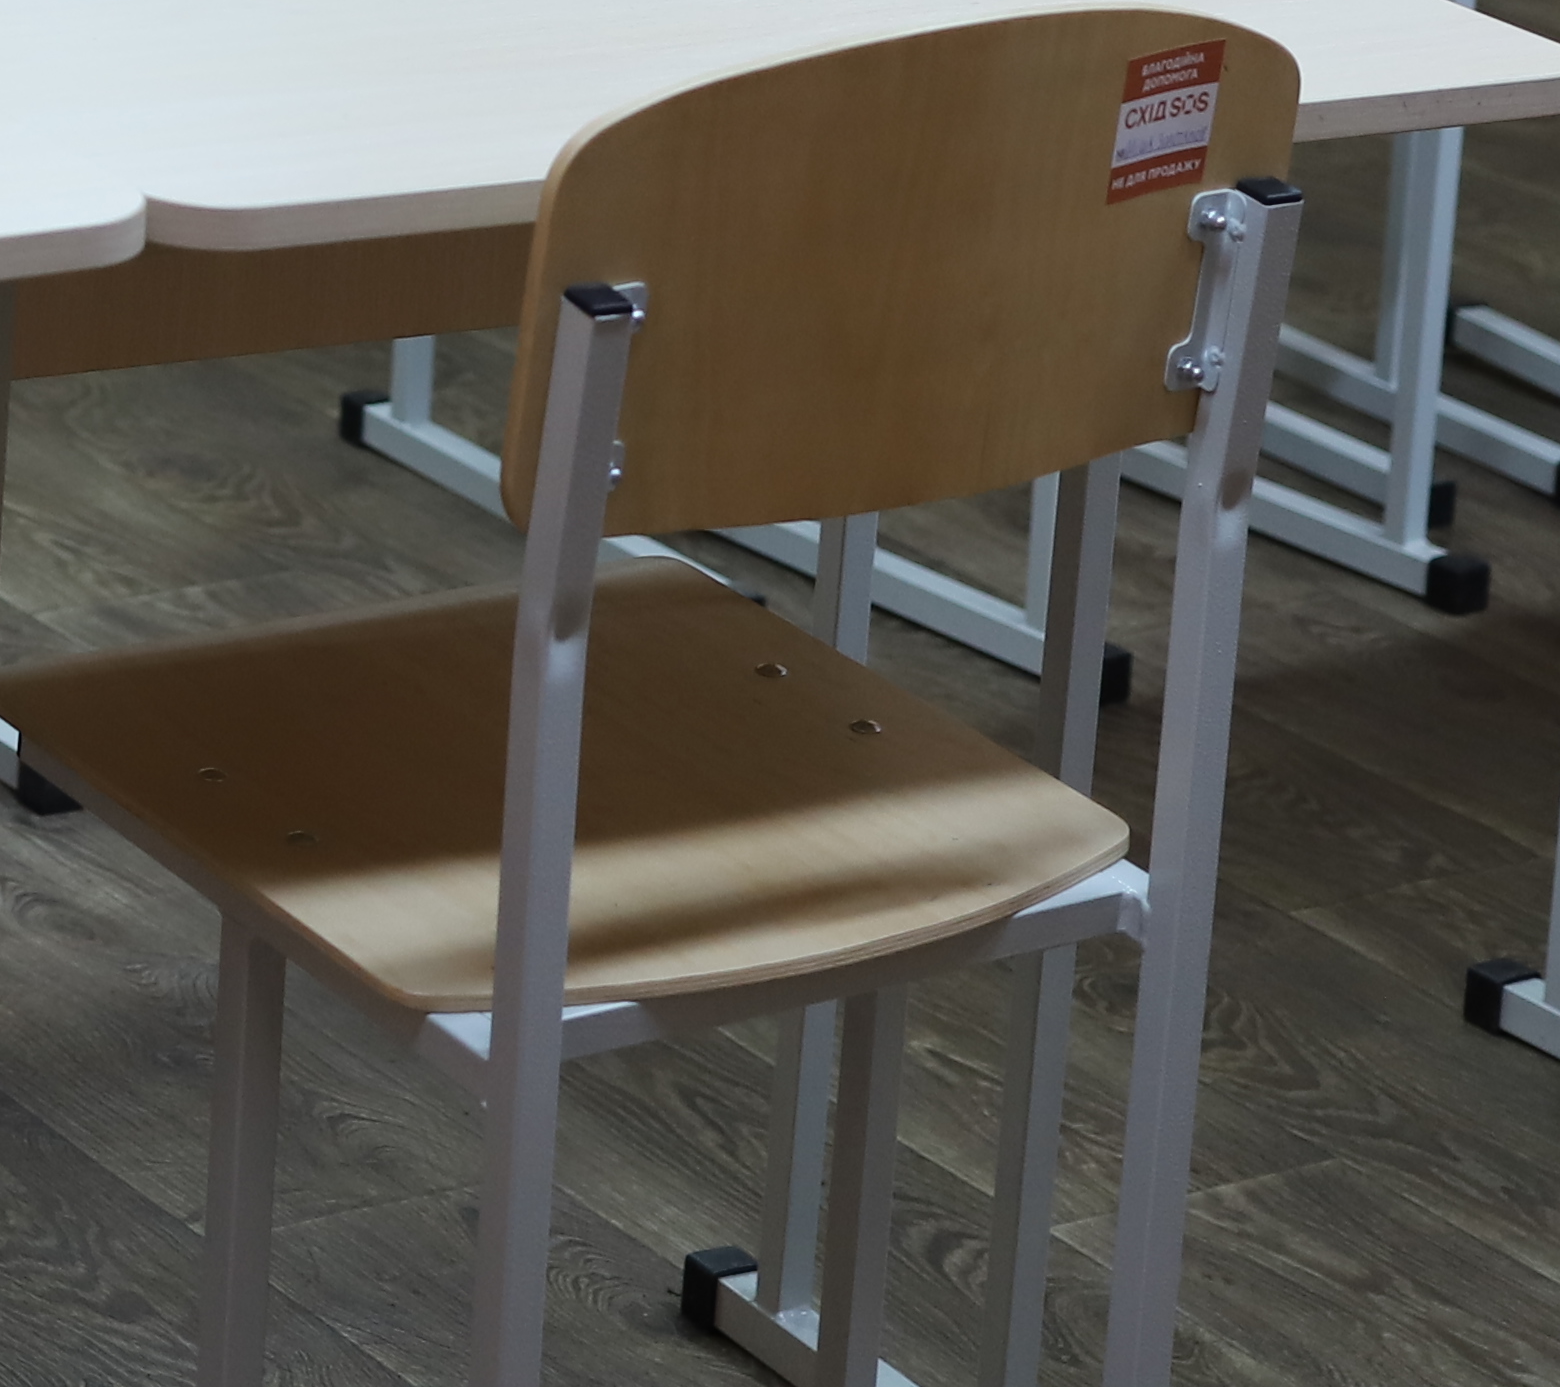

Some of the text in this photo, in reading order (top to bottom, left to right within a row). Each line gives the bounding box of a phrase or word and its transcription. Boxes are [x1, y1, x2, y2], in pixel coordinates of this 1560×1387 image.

[1143, 52, 1205, 76] БЛАГОДІЙНА
[1143, 69, 1199, 92] ДОПОМОГА
[1125, 92, 1210, 129] СХІД SOS
[1112, 159, 1202, 190] НЕ ДЛЯ ПРОДАЖУ
